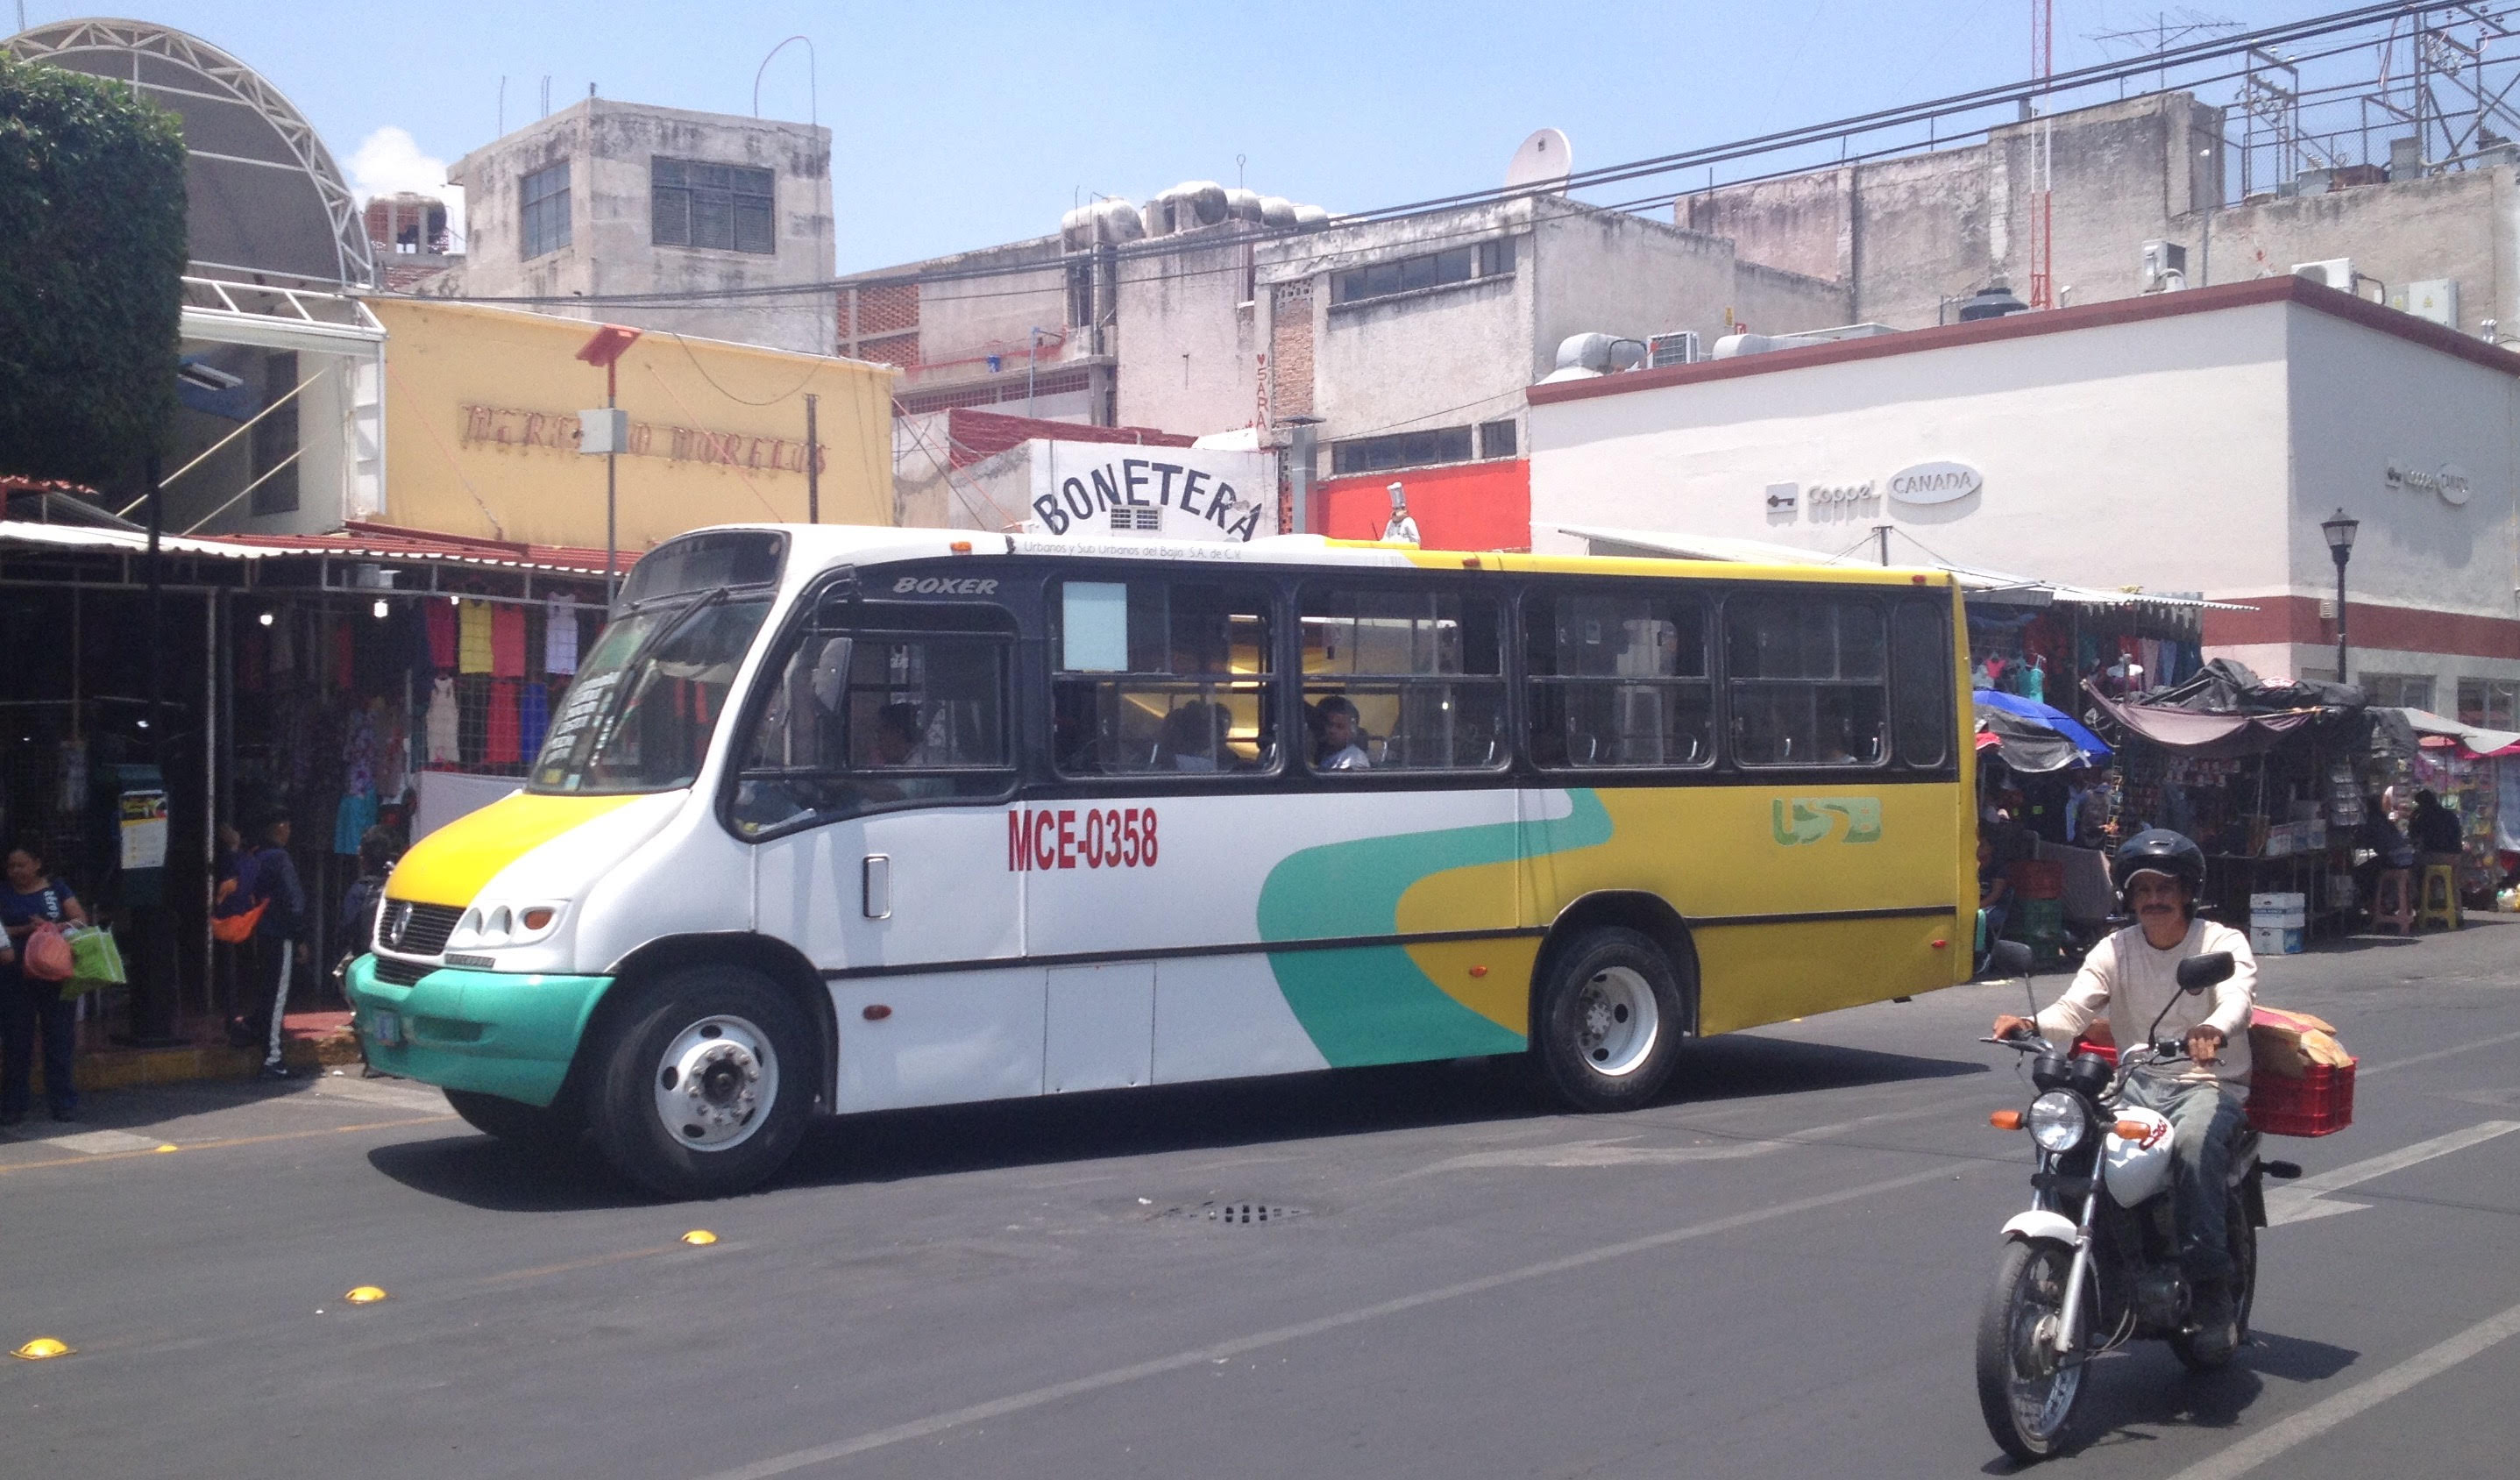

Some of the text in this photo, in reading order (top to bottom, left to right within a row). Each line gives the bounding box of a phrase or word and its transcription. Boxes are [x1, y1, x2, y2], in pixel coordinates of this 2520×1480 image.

[1256, 367, 1269, 431] SARA
[1033, 459, 1263, 543] BONETERA
[1892, 472, 1972, 495] CANADA
[1024, 541, 1067, 552] Urbanos
[1068, 544, 1075, 556] y
[1077, 542, 1096, 554] Sub
[1098, 544, 1139, 556] Urbanos
[1142, 546, 1158, 557] del
[1210, 549, 1223, 559] de
[892, 577, 999, 594] BOXER
[1008, 807, 1158, 872] MCE-0358
